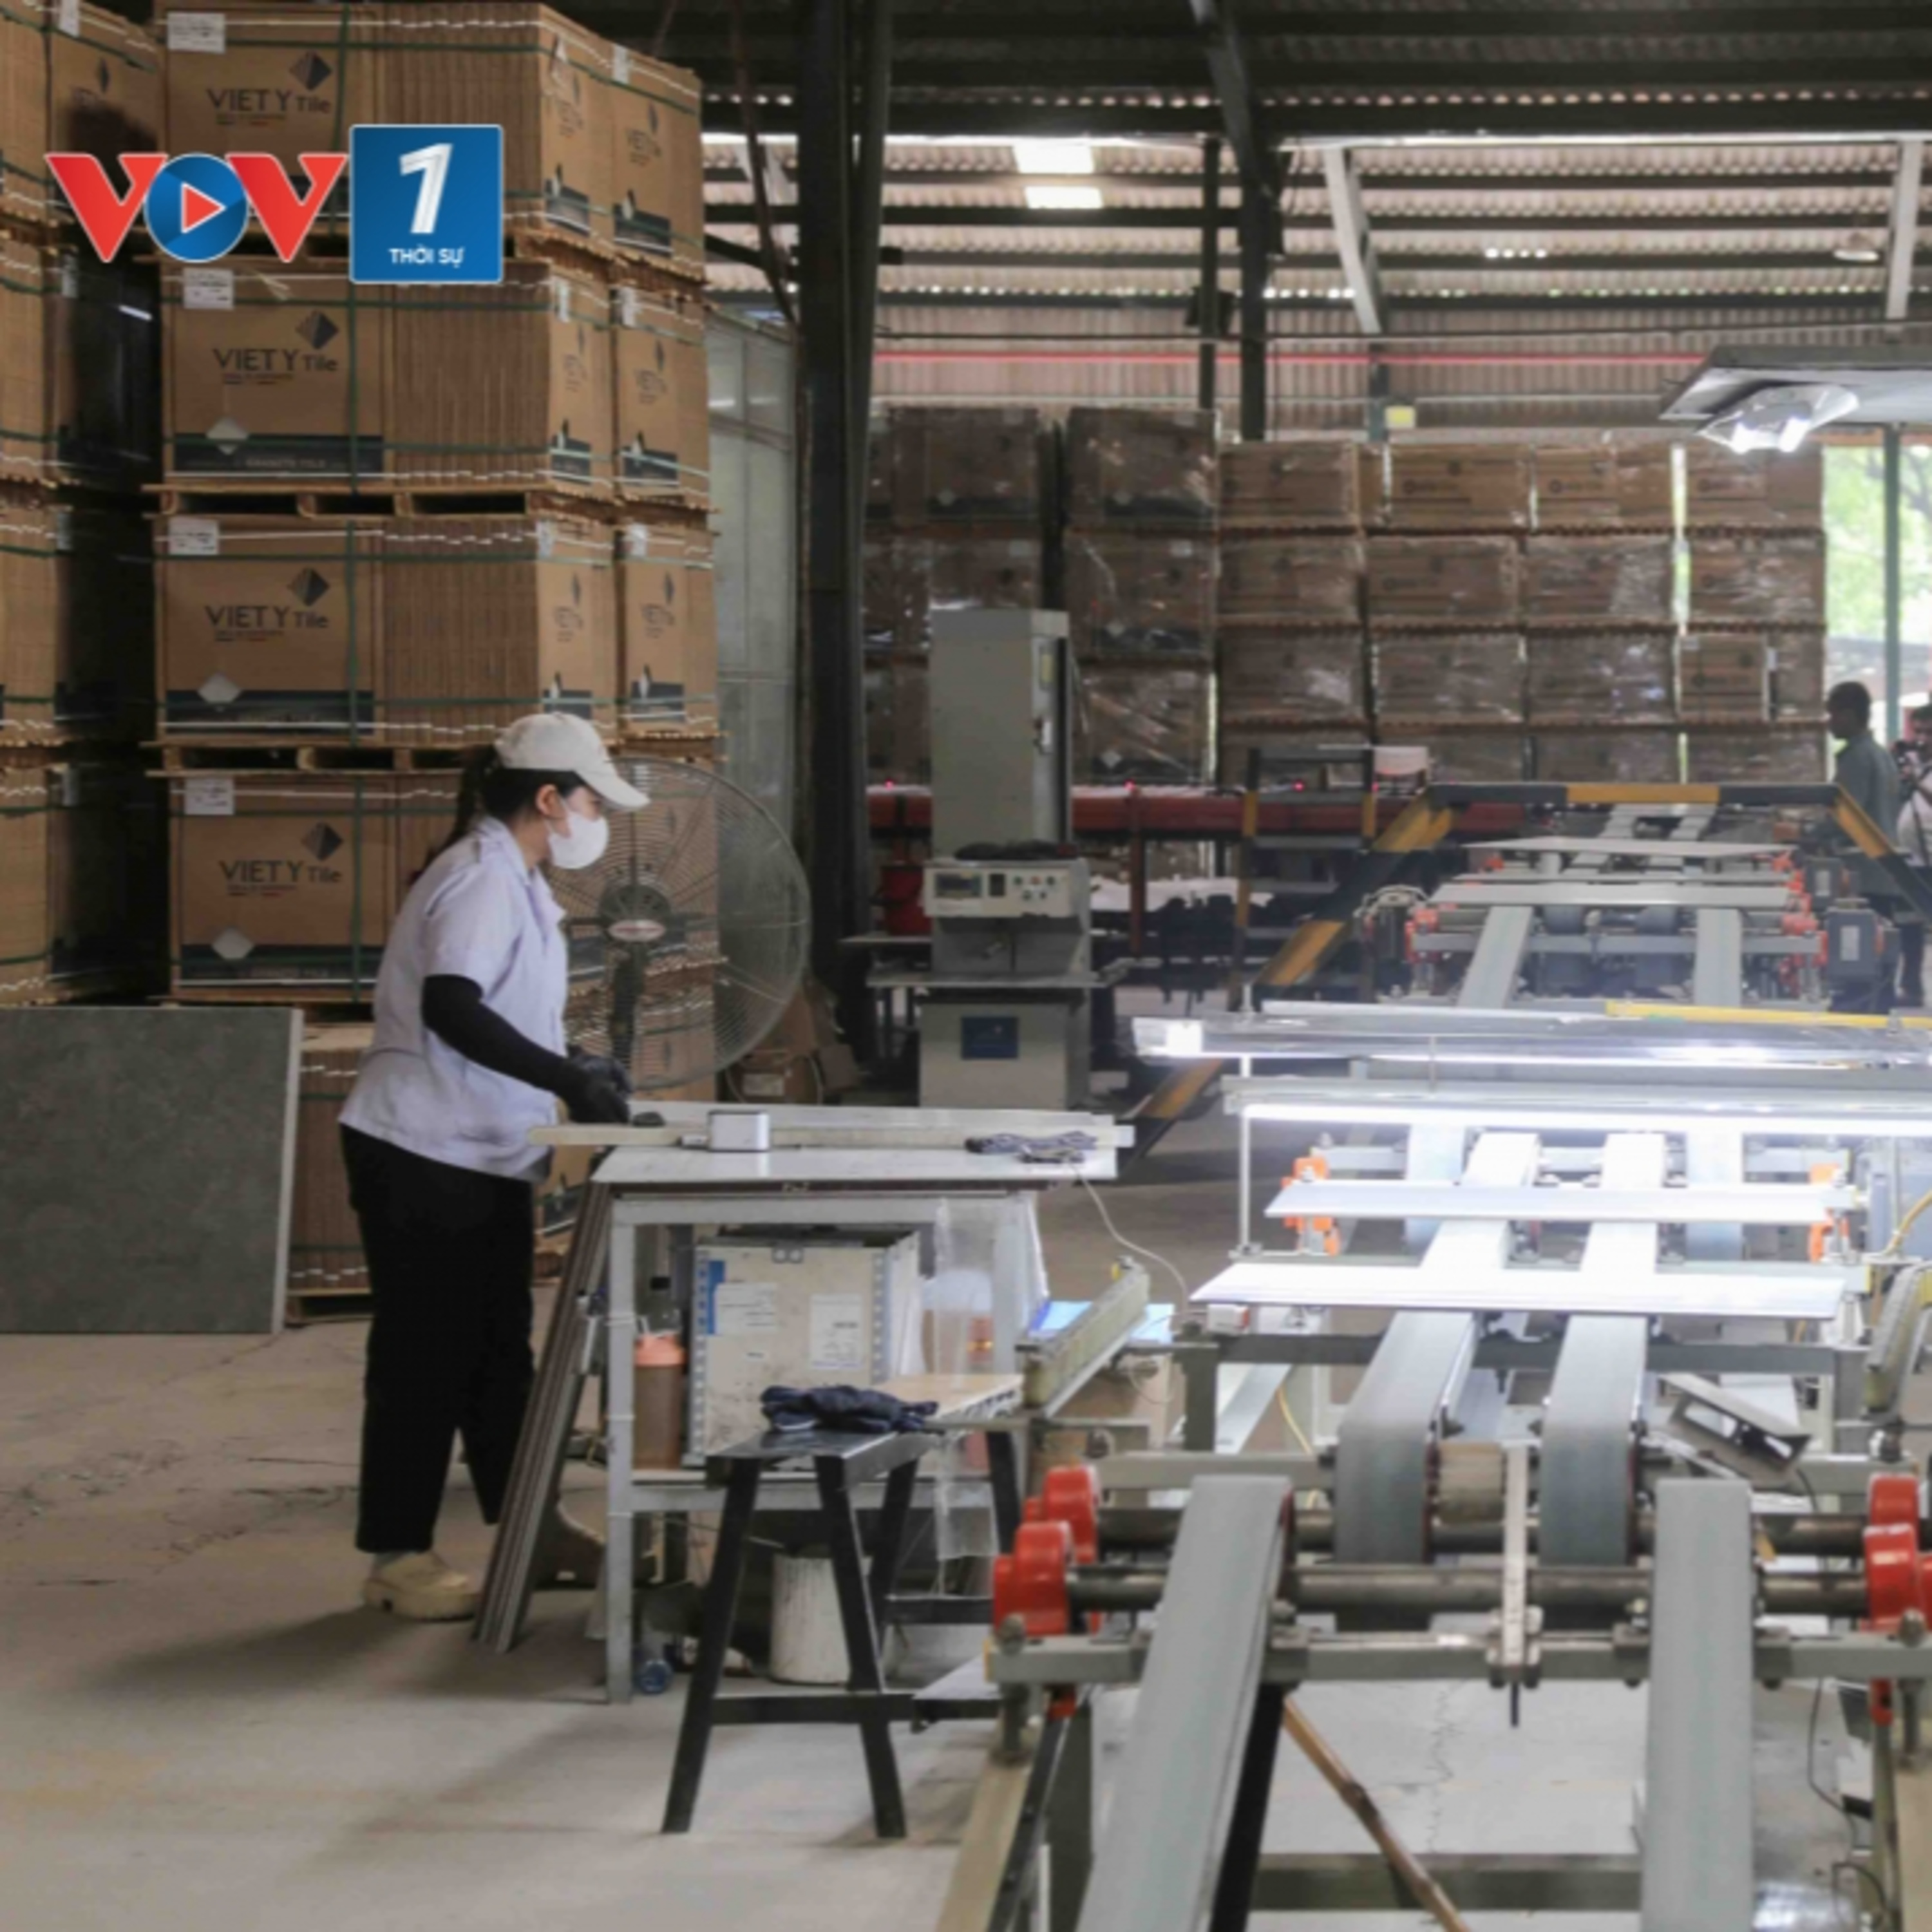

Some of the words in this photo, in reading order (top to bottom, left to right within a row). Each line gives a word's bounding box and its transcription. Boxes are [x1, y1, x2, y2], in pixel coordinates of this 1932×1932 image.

[296, 95, 332, 113] Tile
[303, 355, 338, 372] Tile
[294, 611, 330, 629] Tile
[307, 866, 343, 884] Tile
